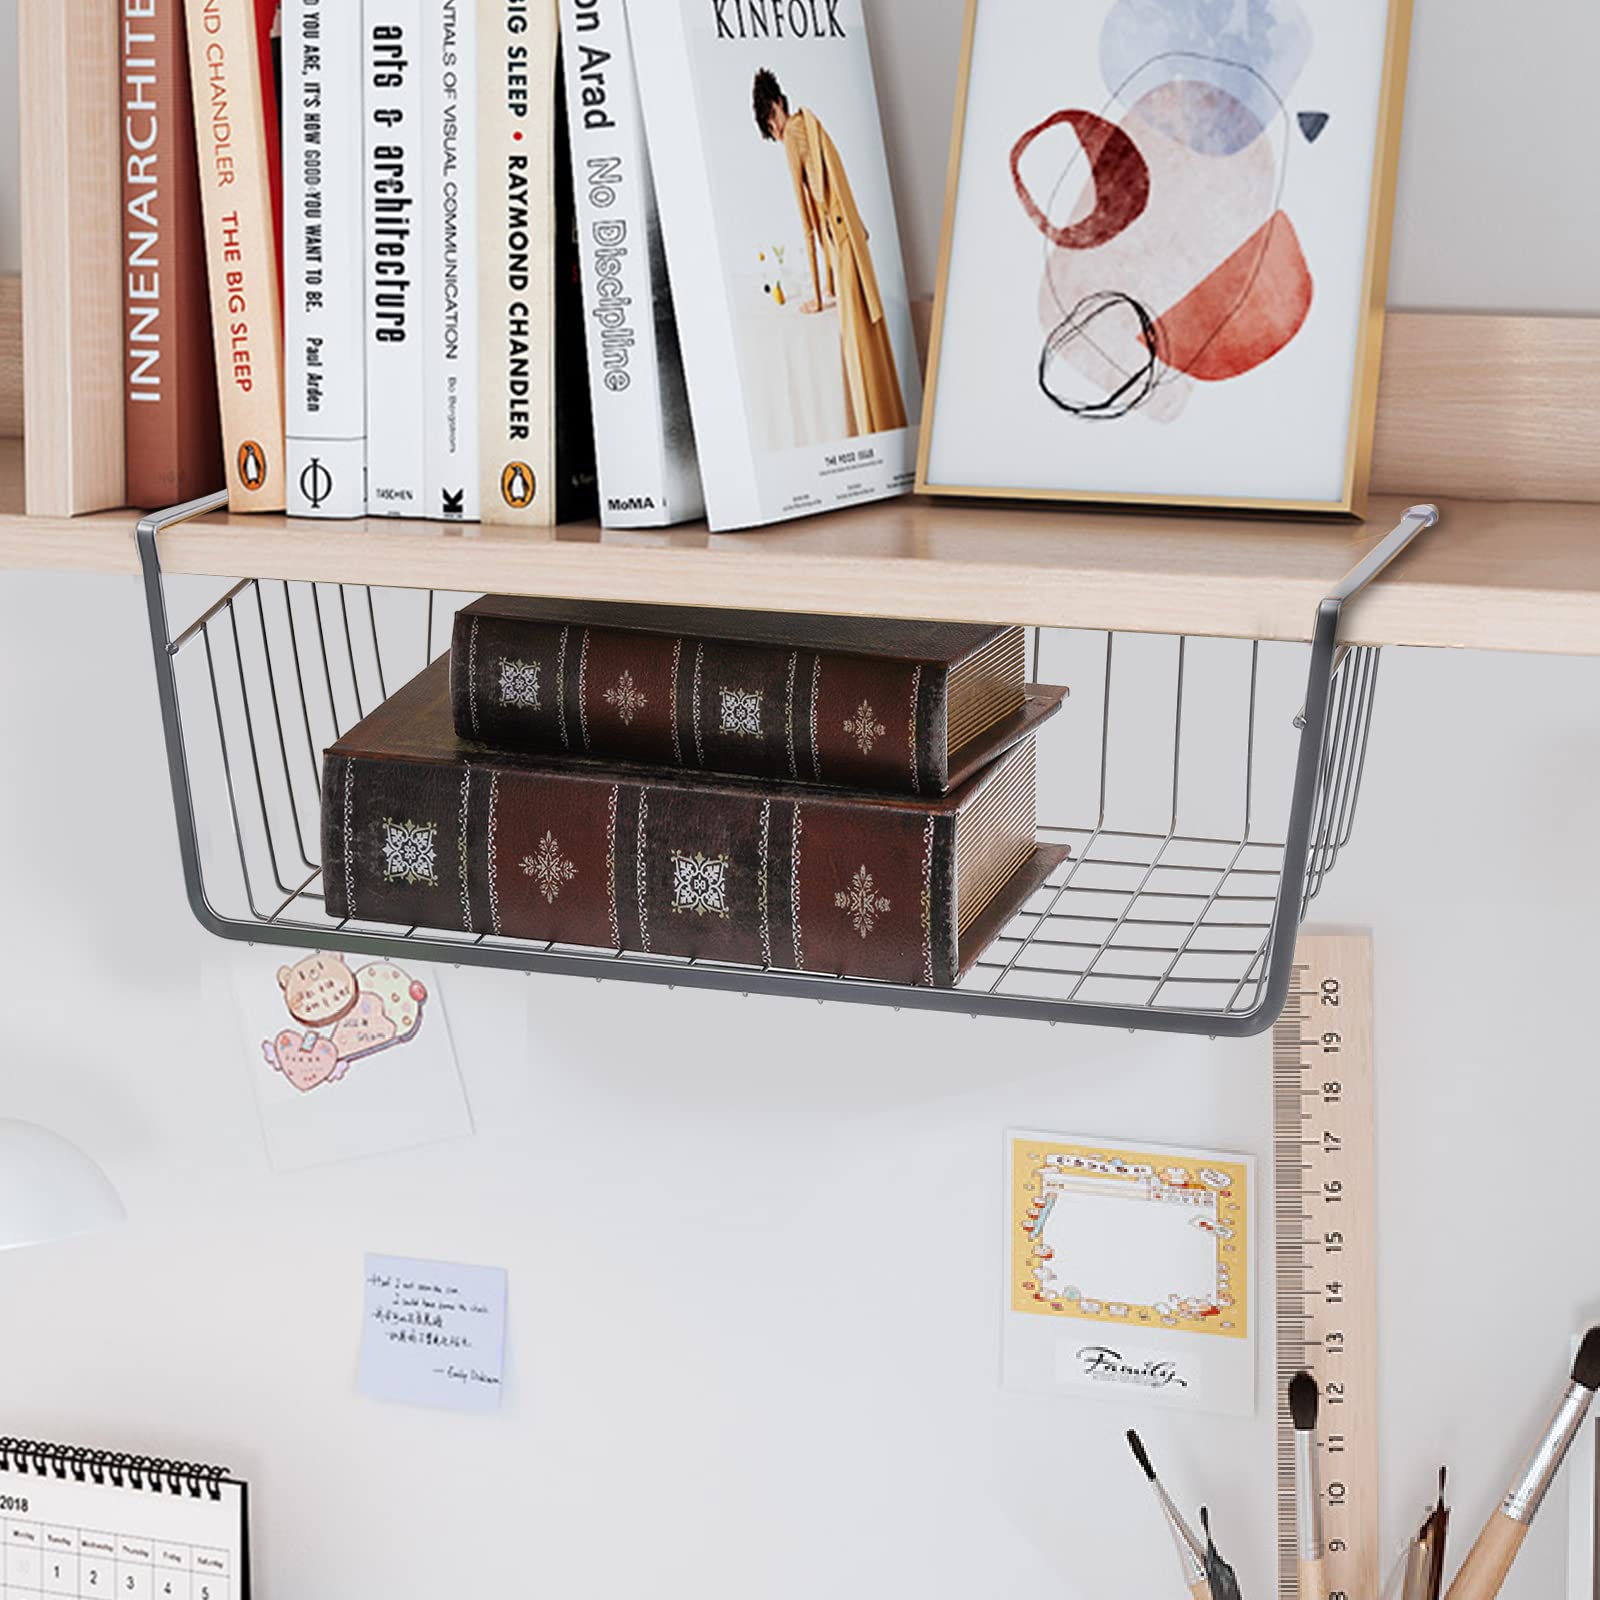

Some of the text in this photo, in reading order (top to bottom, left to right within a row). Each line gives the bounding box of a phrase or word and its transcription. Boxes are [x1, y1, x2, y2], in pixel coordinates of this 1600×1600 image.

[302, 12, 320, 39] YOU
[712, 0, 846, 39] KINFOLK
[302, 45, 321, 75] ARE,
[373, 26, 408, 87] arts
[303, 82, 321, 108] IT'S
[443, 72, 457, 100] OF
[507, 46, 527, 117] SLEEP
[577, 45, 616, 129] Arad
[206, 43, 235, 187] CHANDLER
[303, 113, 321, 144] HOW
[443, 104, 458, 177] VISUAL
[304, 150, 321, 186] GOOD
[587, 157, 623, 208] No
[304, 192, 322, 218] YOU
[221, 210, 242, 263] THE
[508, 156, 528, 290] RAYMOND
[305, 224, 322, 262] WANT
[374, 146, 413, 342] architecture
[305, 269, 322, 285] TO
[443, 181, 459, 359] COMMUNICATION
[226, 271, 247, 314] BIG
[305, 291, 323, 313] BE.
[592, 220, 636, 392] Discipline
[230, 323, 253, 393] SLEEP
[508, 302, 529, 440] CHANDLER
[306, 337, 323, 412] Paul Arden
[376, 488, 413, 500] TASCHEN
[607, 497, 655, 510] MoMA
[1320, 978, 1340, 1007] 20
[1322, 1032, 1341, 1053] 19
[1323, 1081, 1341, 1103] 18
[1323, 1130, 1342, 1153] 17
[1323, 1180, 1343, 1203] 16
[1324, 1231, 1343, 1253] 15
[1325, 1281, 1343, 1303] 14
[1325, 1332, 1343, 1353] 13
[1075, 1346, 1188, 1388] Family
[1326, 1382, 1344, 1404] 12
[1328, 1435, 1344, 1453] 11
[0, 1495, 29, 1513] 2018
[1328, 1481, 1345, 1506] 10
[1328, 1538, 1347, 1552] 9
[54, 1565, 209, 1600] 1 2 3 4 5
